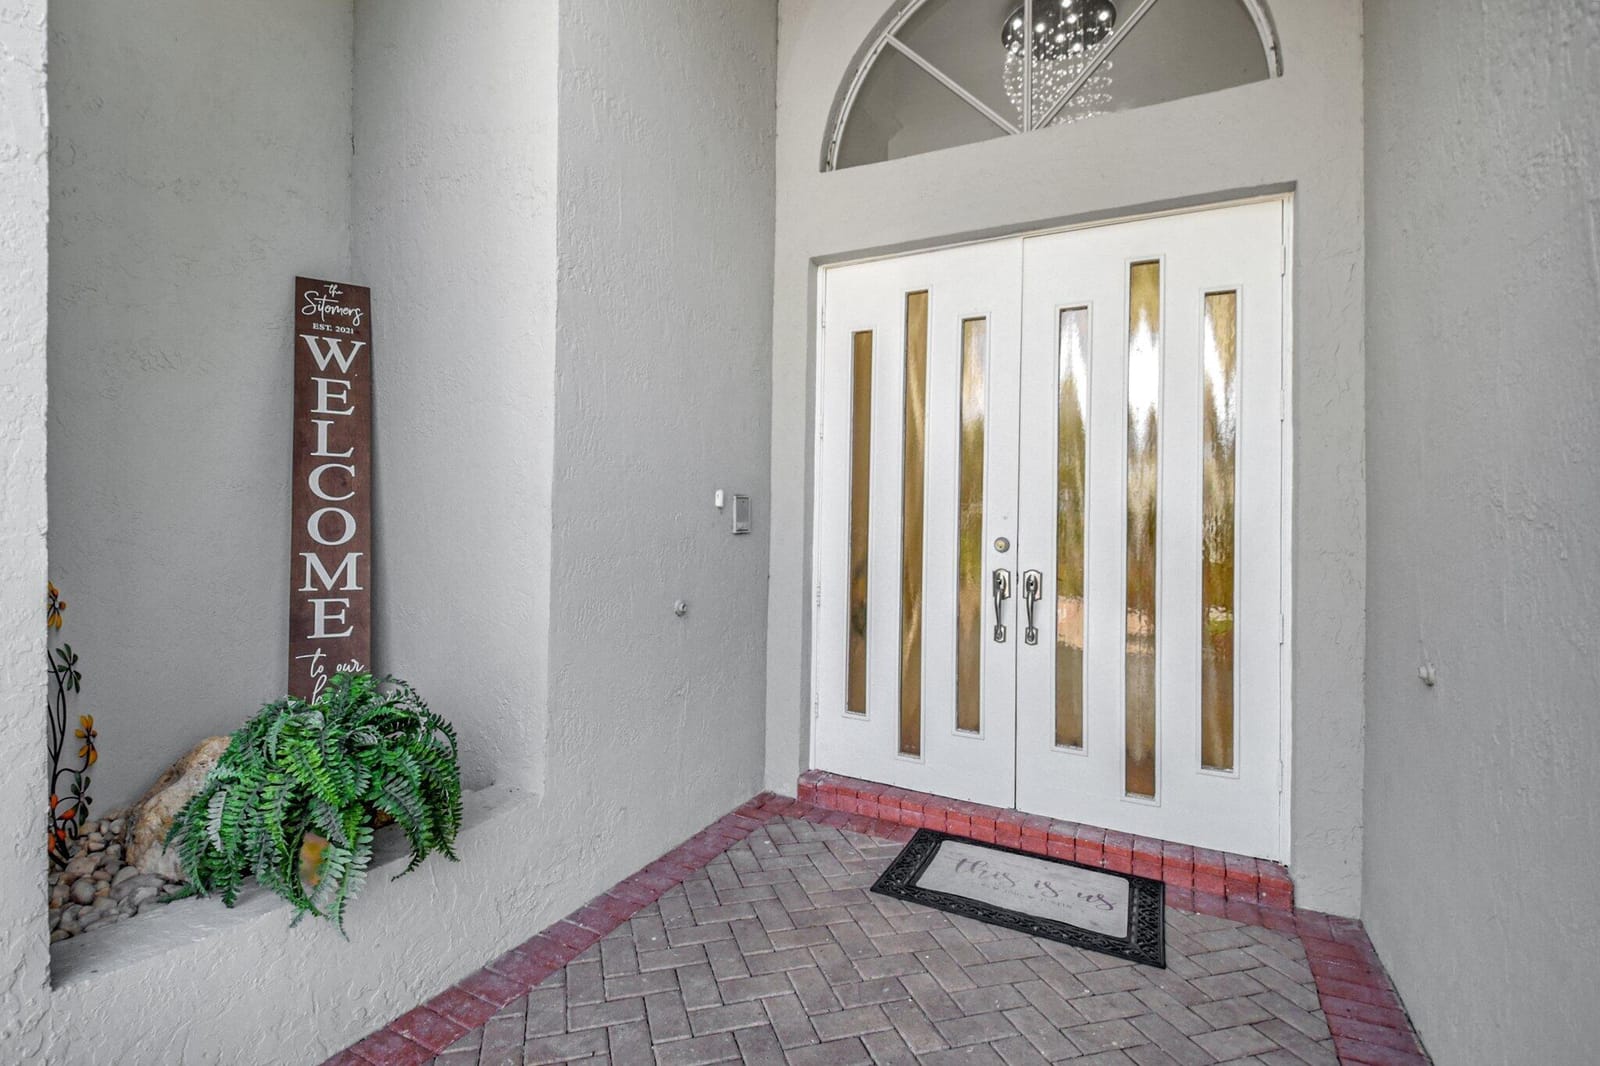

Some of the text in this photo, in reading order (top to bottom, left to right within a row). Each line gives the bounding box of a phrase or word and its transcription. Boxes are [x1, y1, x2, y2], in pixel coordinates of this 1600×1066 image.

[323, 284, 343, 297] the
[312, 322, 354, 335] EST. 2021
[298, 333, 367, 640] WELCOME
[295, 647, 366, 678] to our
[954, 857, 1016, 888] this
[1034, 880, 1064, 898] is
[1077, 892, 1118, 911] us
